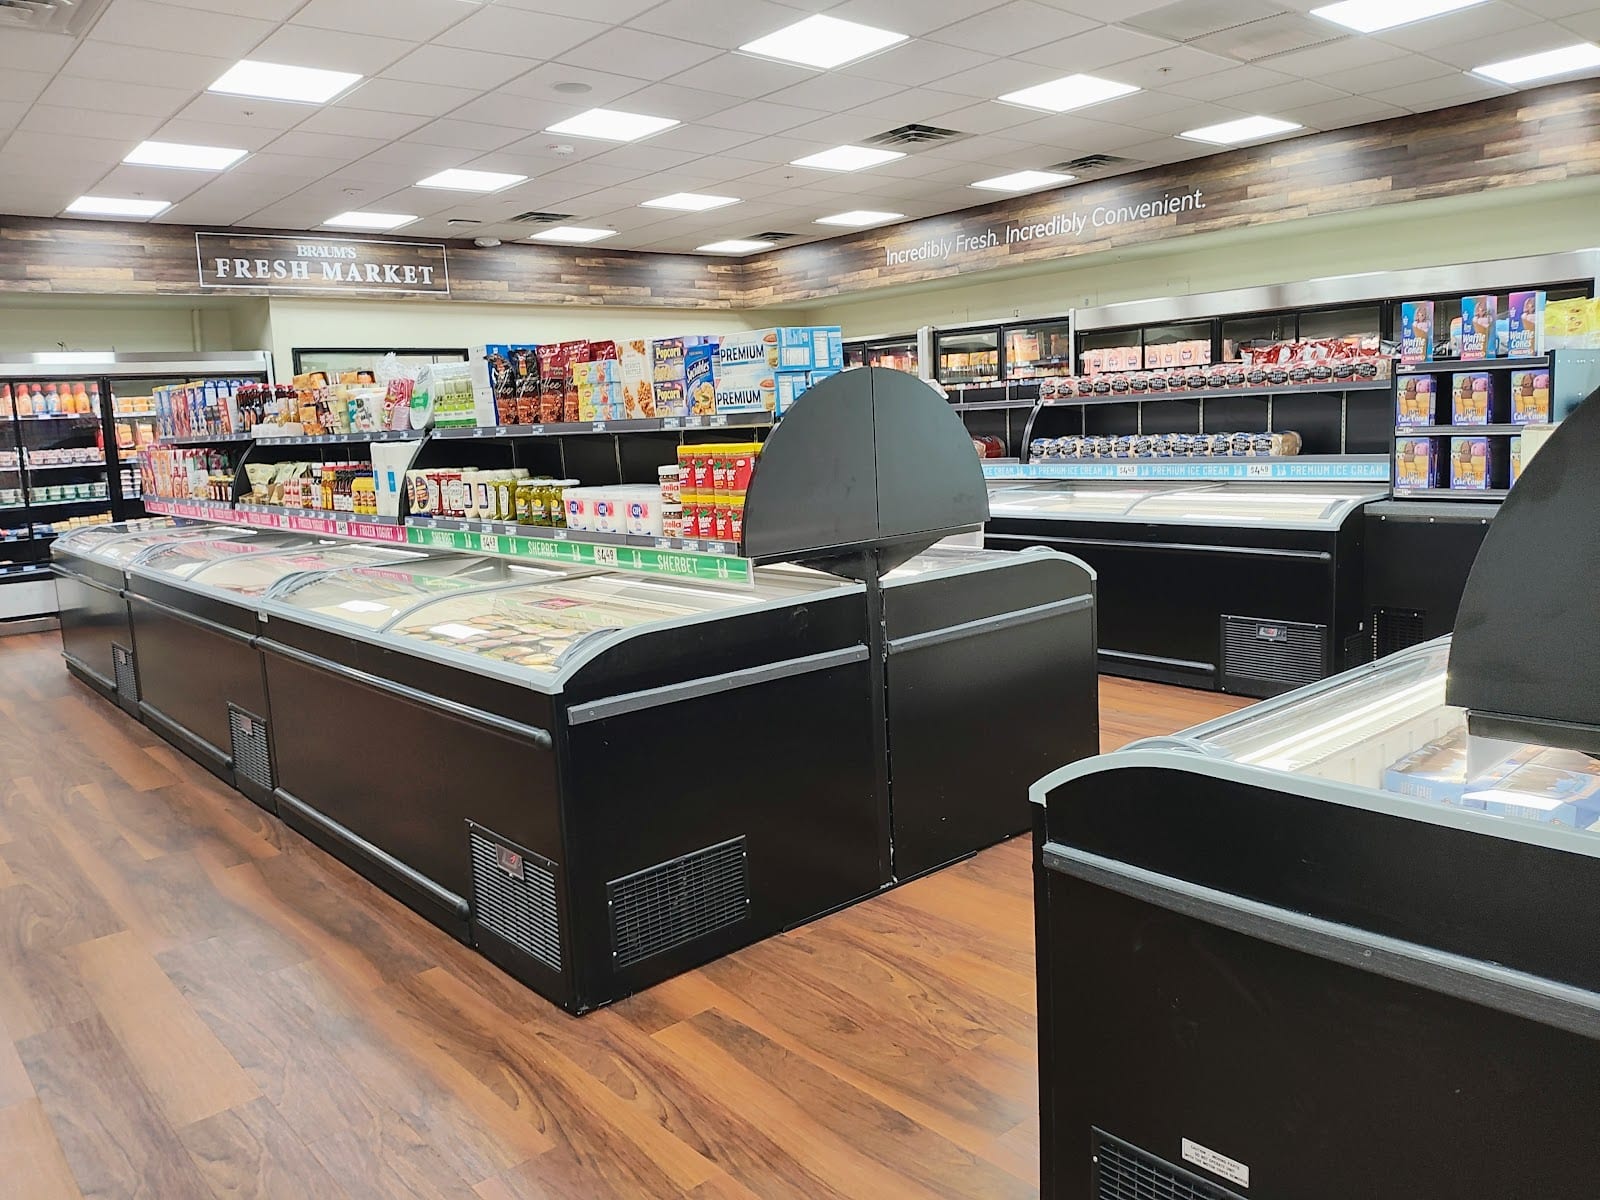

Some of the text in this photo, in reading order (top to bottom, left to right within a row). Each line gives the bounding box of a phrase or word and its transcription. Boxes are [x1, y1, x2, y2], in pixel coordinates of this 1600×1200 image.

[886, 188, 1206, 266] Incredibly Fresh. Incredibly Convenient.
[215, 258, 433, 285] FRESH MARKET
[655, 346, 681, 361] Popcorn
[720, 344, 765, 362] PREMIUM
[656, 388, 681, 402] Popcorn
[716, 389, 762, 406] PREMIUM
[1152, 464, 1230, 476] PREMIUM ICE CREAM
[1290, 464, 1383, 476] PREMIUM ICE CREAM
[359, 524, 376, 538] FROZEN
[431, 531, 455, 546] SHERBET
[527, 540, 559, 558] SHERBET
[657, 554, 698, 575] SHERBET
